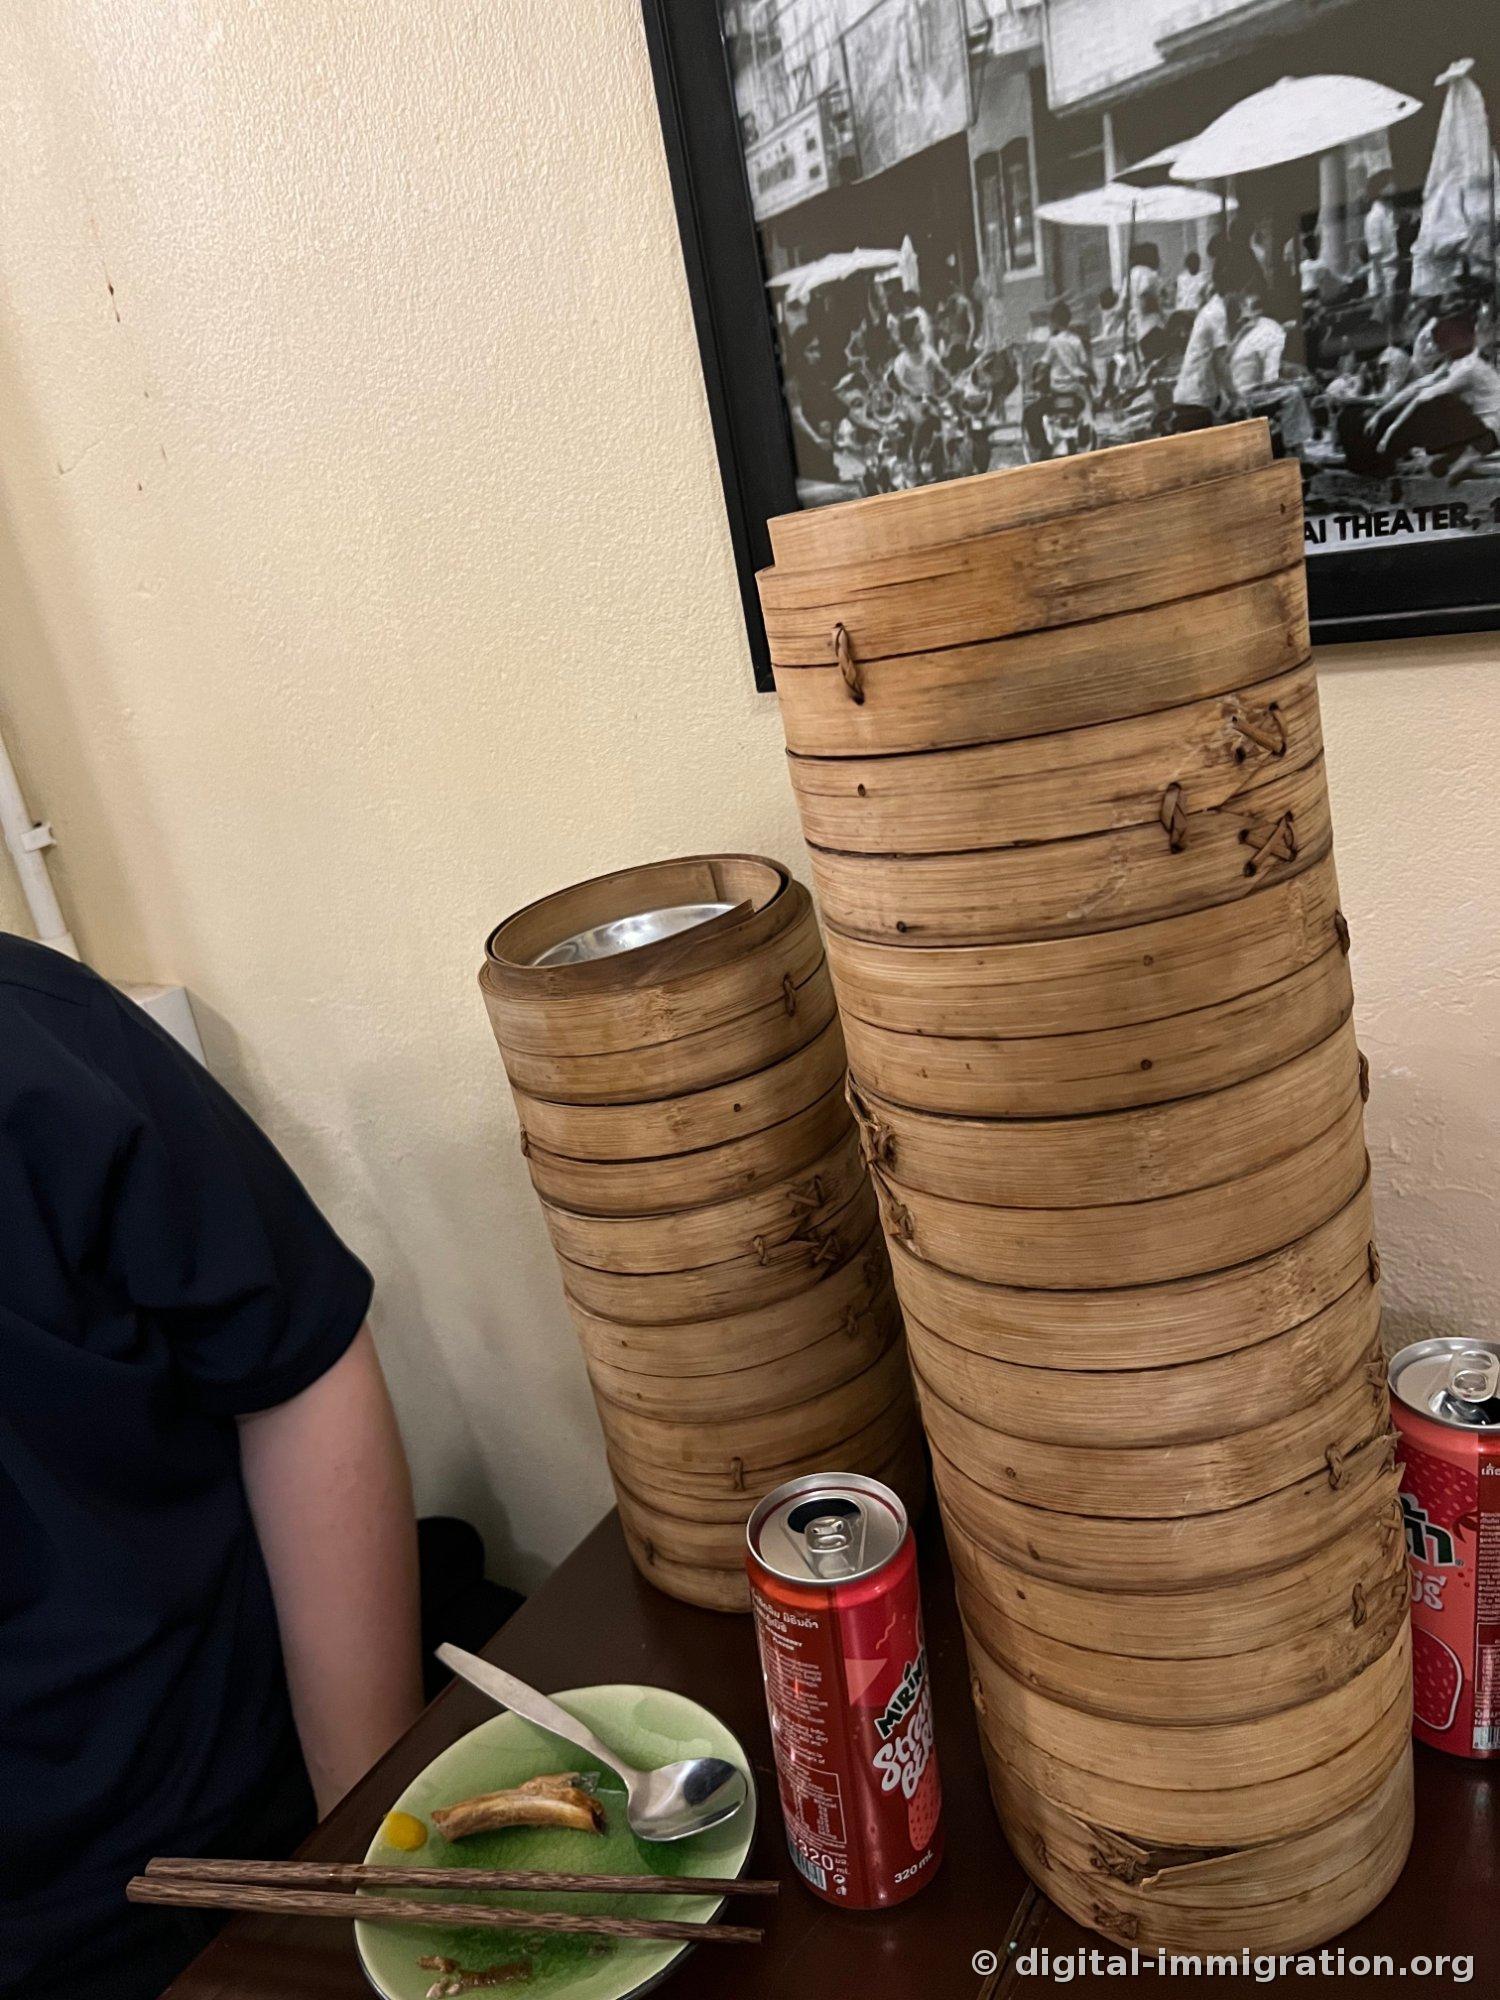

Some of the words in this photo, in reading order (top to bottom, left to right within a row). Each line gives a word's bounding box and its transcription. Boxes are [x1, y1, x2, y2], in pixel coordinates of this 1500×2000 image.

[1304, 519, 1326, 544] AI
[1334, 501, 1480, 541] THEATER,
[798, 1839, 834, 1871] 320
[894, 1863, 917, 1884] 320
